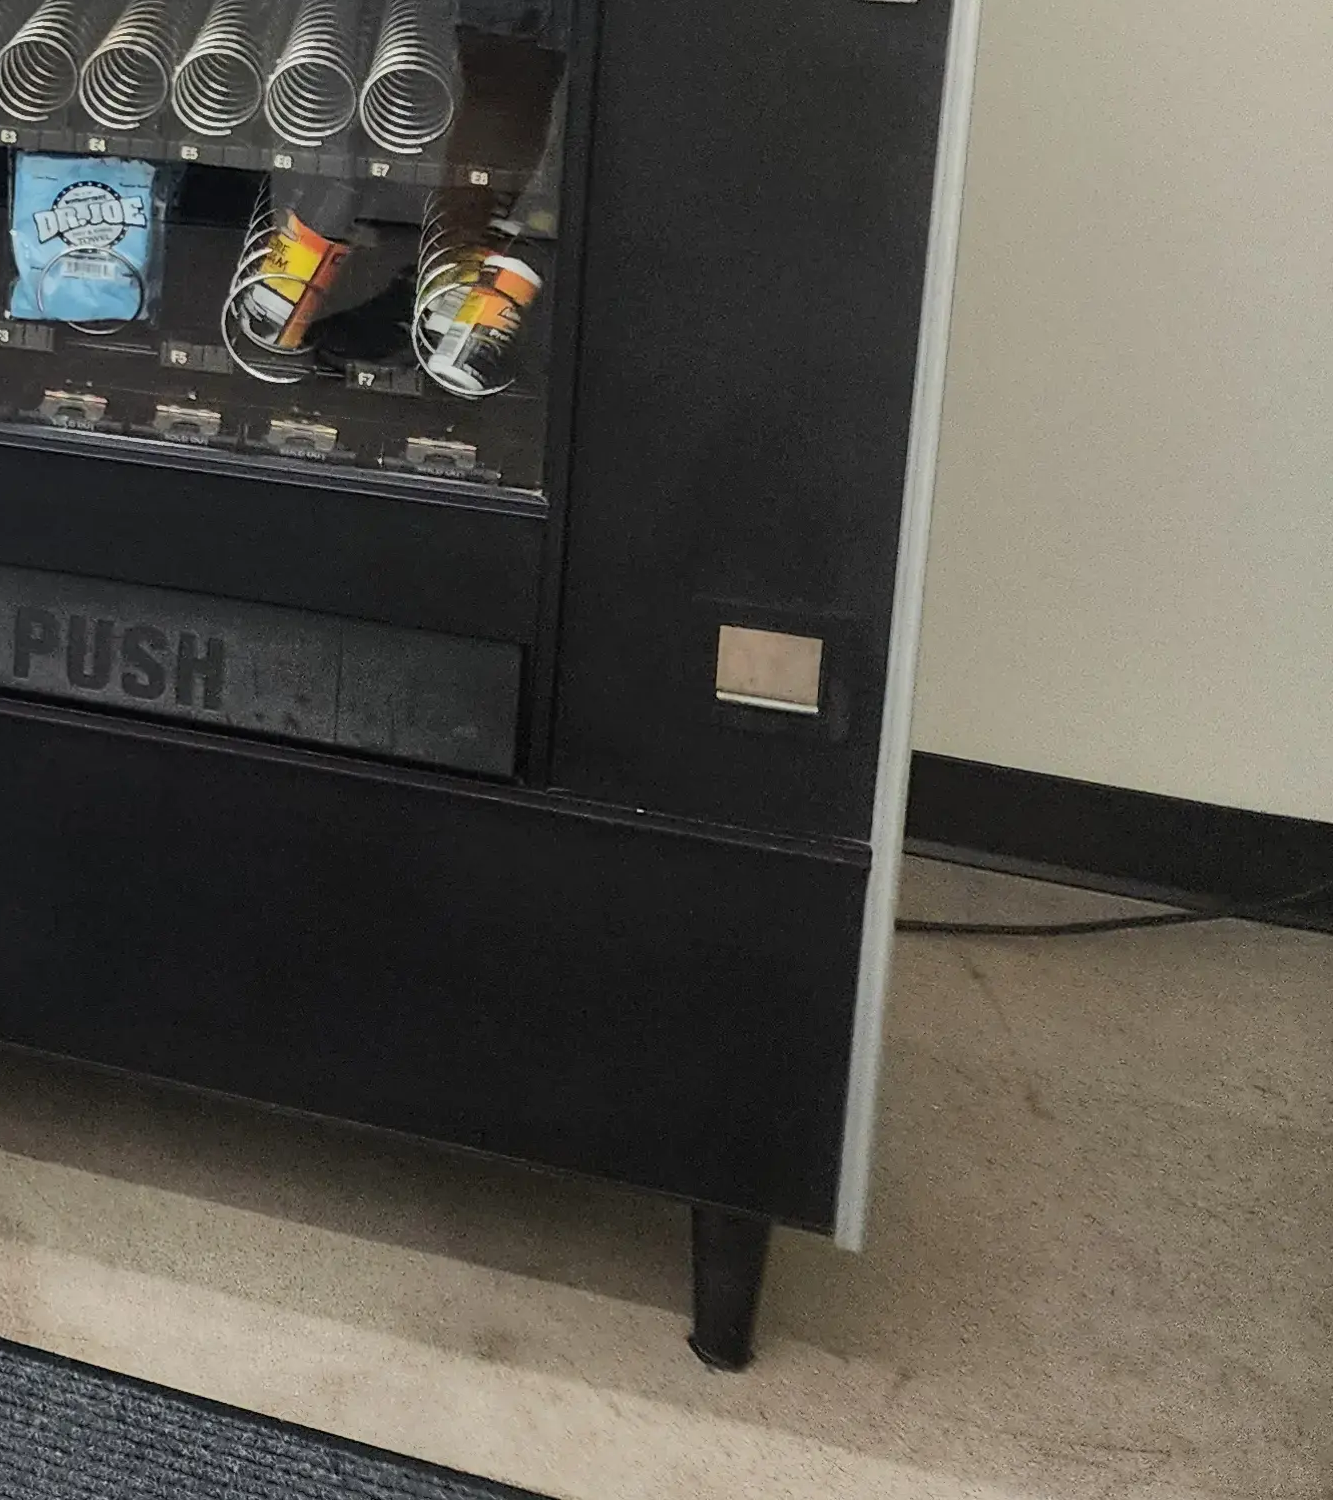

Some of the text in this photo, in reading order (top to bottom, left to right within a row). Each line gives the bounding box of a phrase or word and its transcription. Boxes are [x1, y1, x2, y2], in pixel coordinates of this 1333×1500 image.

[89, 137, 106, 151] E4
[371, 162, 390, 177] E7
[358, 372, 375, 386] F7
[13, 605, 226, 712] PUSH
